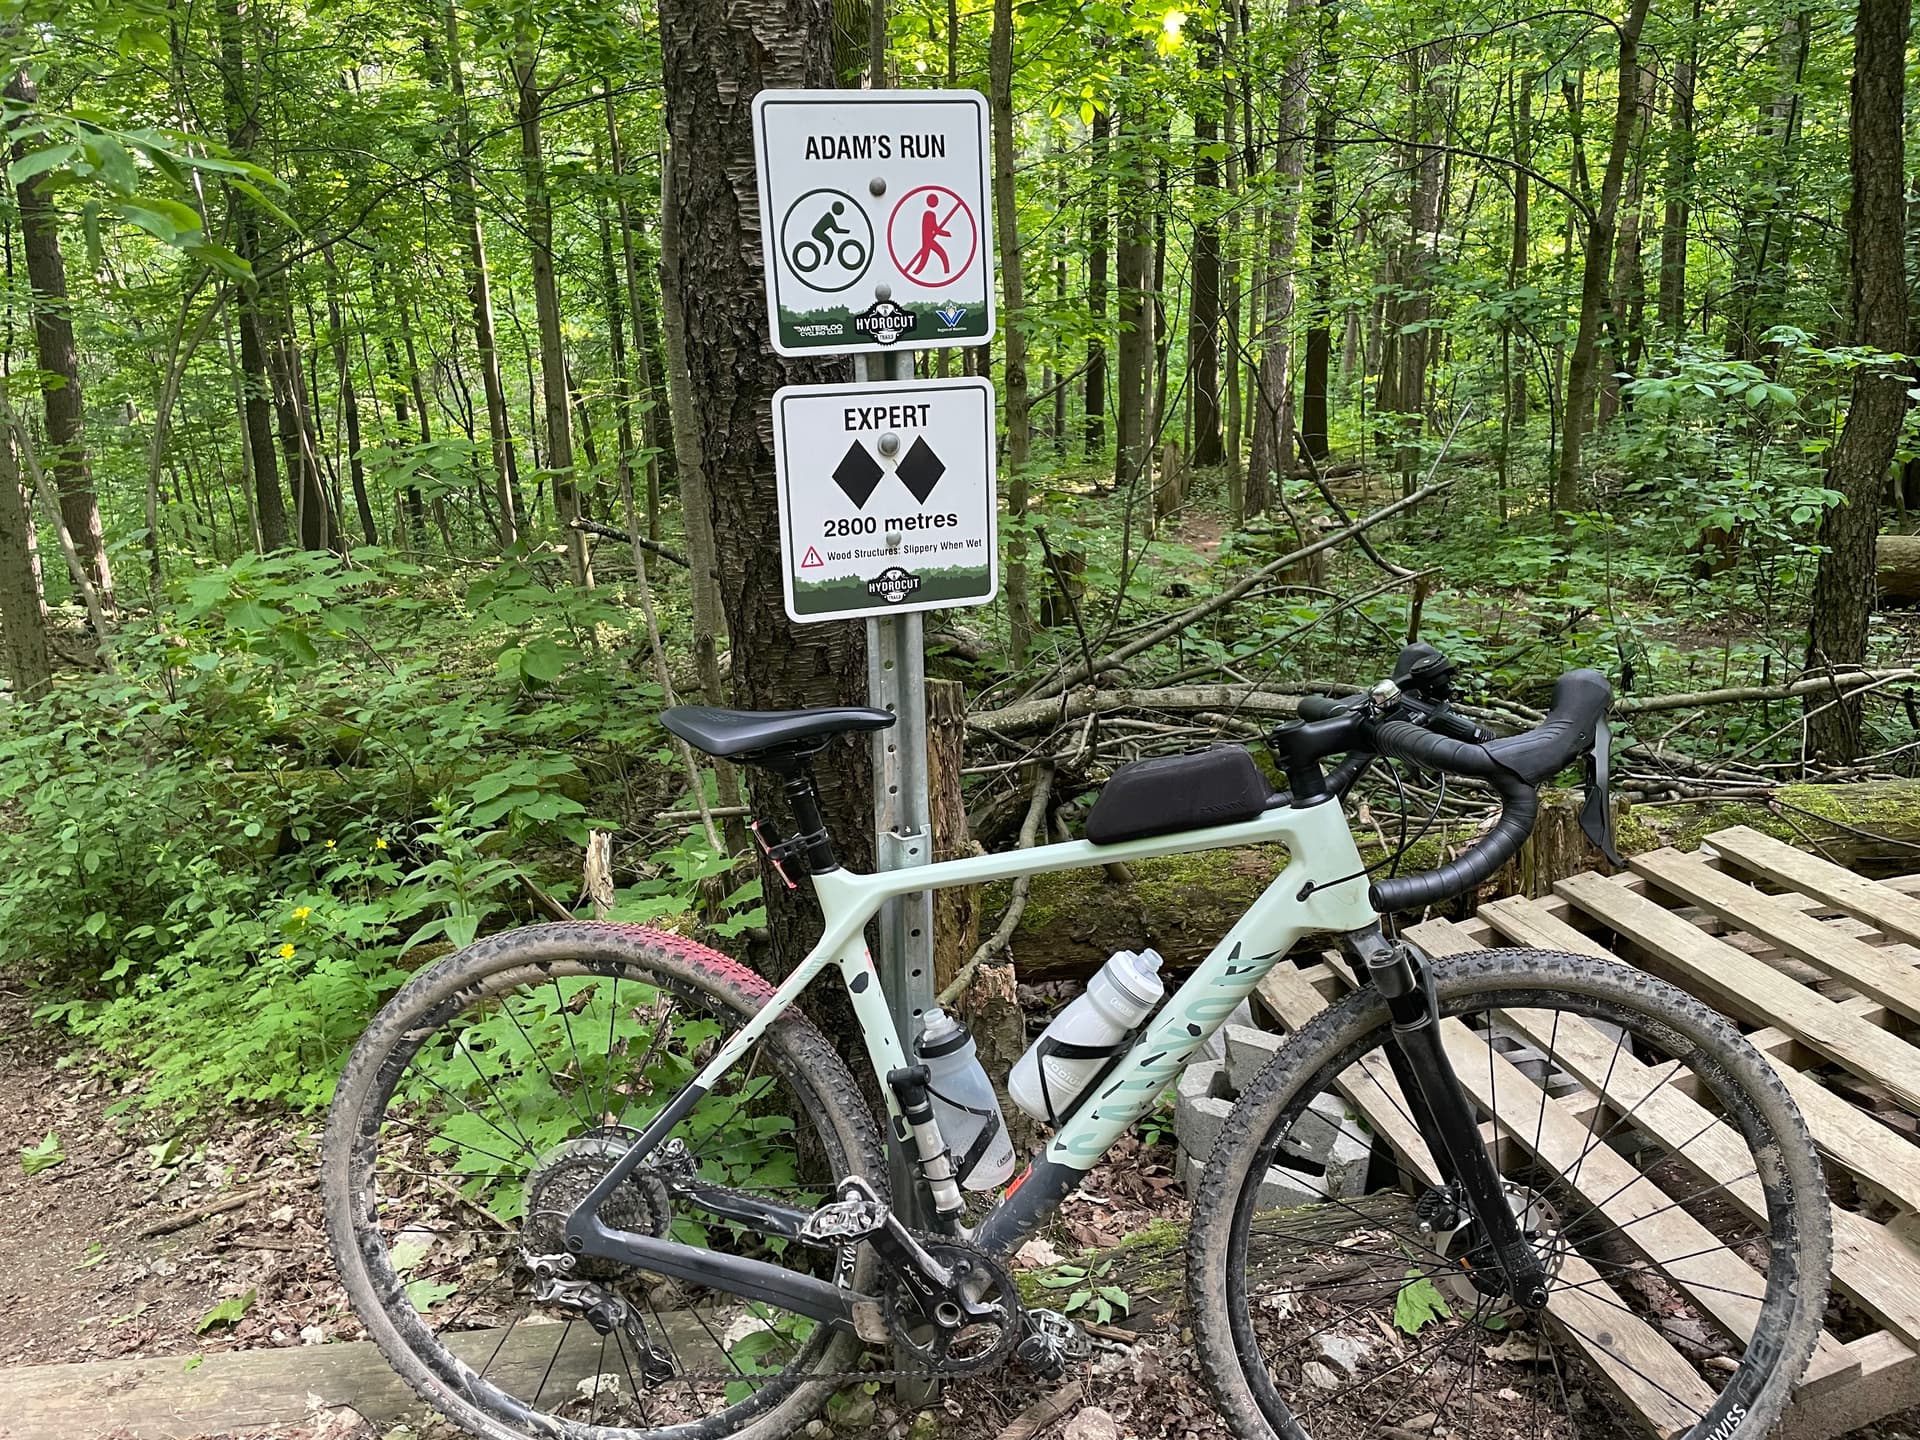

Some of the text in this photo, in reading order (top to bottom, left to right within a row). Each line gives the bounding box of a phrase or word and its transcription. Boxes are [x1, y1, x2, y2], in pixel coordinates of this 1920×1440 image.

[805, 134, 945, 160] ADAM'S RUN
[800, 323, 844, 332] WATERLOO
[856, 315, 915, 331] HYDROCUT
[844, 404, 931, 431] EXPERT
[823, 512, 958, 538] 2800 metres
[827, 549, 851, 561] Wood
[903, 543, 938, 555] Slippery
[940, 540, 964, 550] When
[965, 538, 982, 549] Wet
[868, 578, 920, 593] HYDROCUT
[1704, 1402, 1747, 1440] WISS
